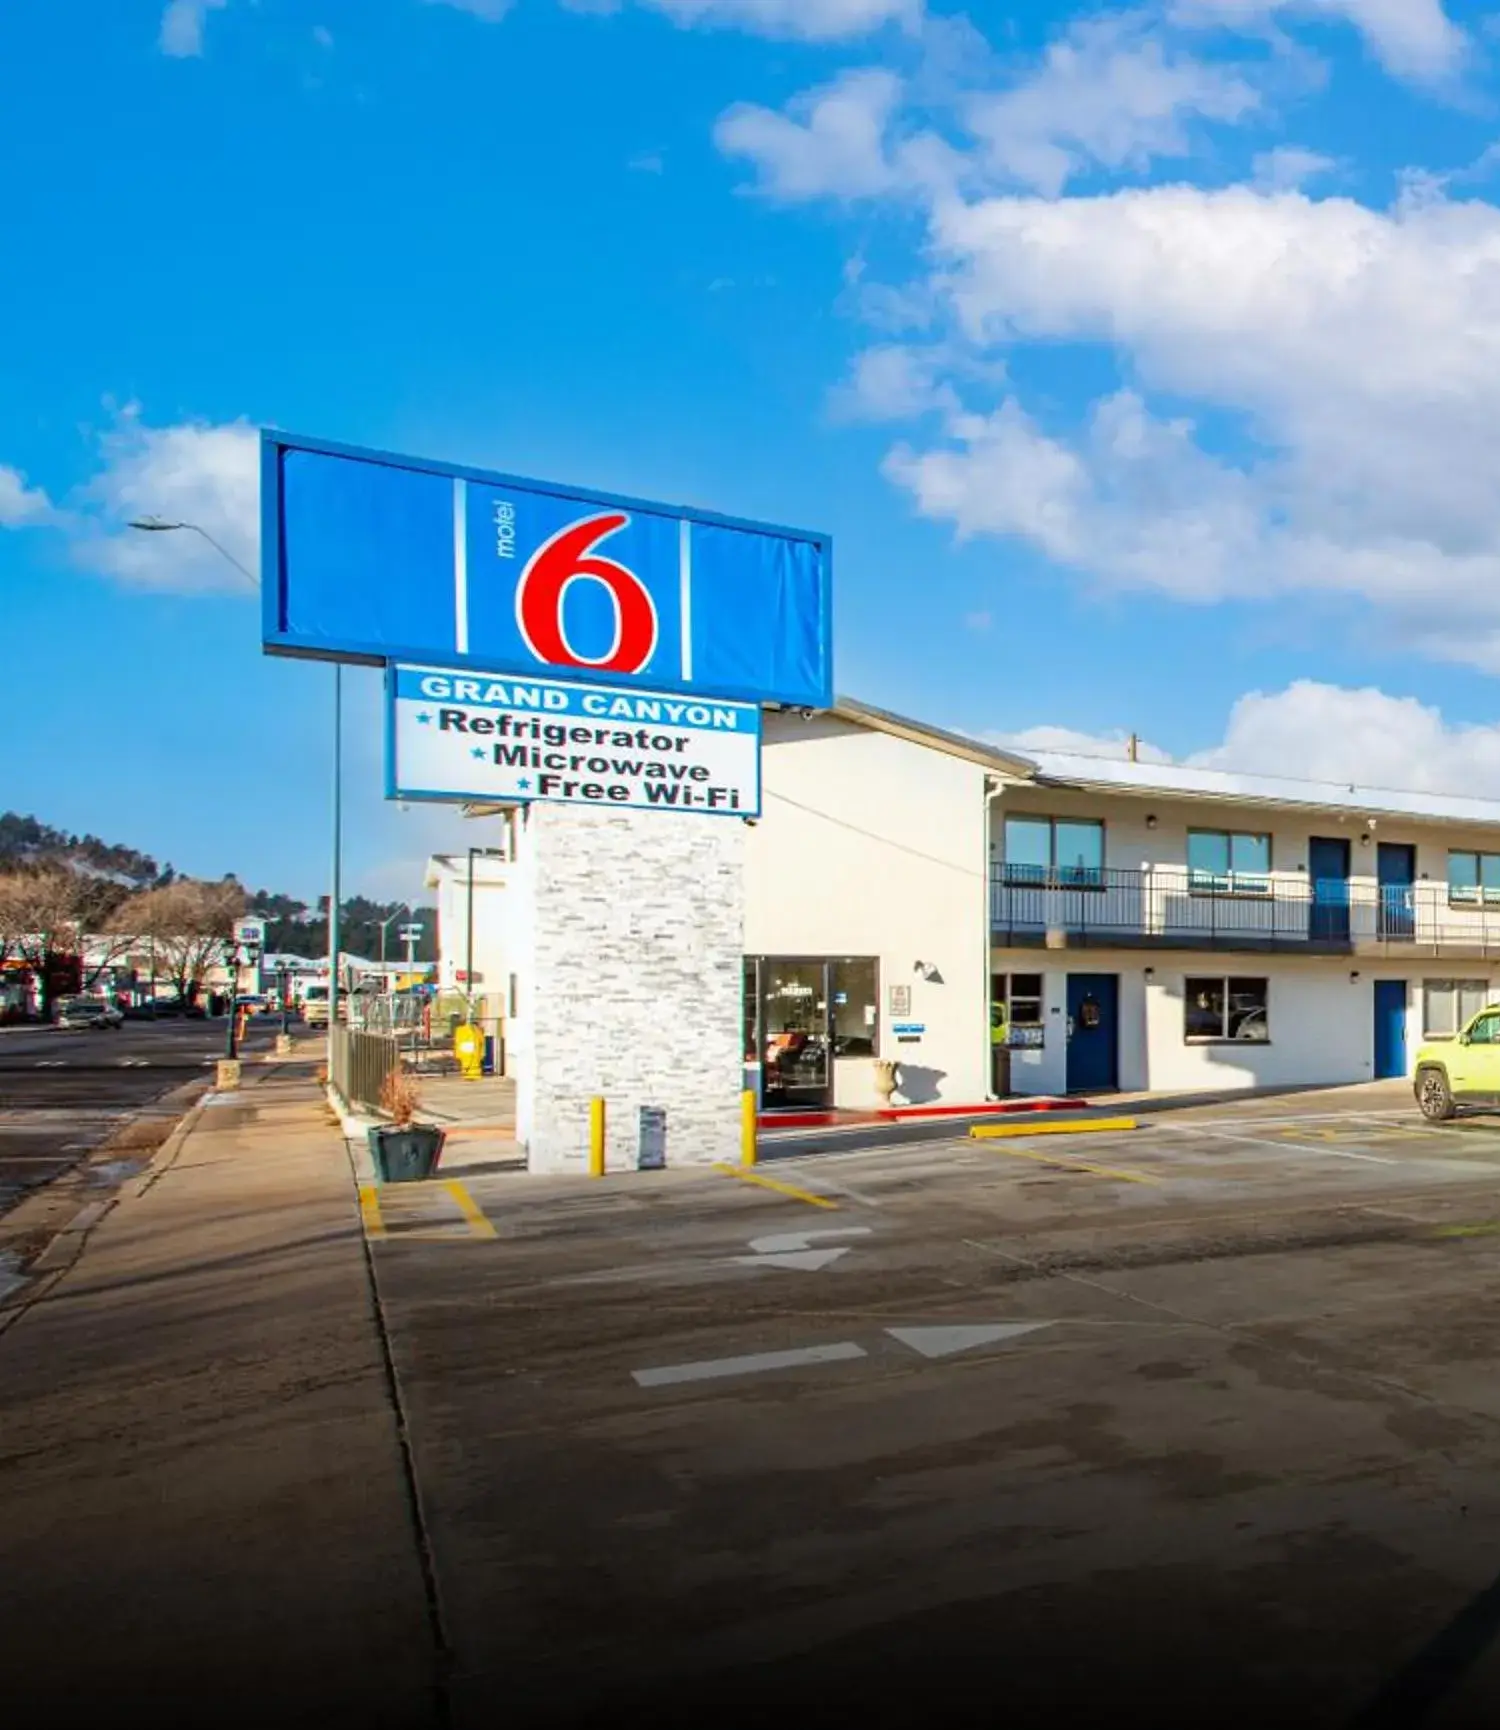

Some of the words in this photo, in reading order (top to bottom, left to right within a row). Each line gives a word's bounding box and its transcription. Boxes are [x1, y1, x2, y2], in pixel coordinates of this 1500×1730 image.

[493, 500, 516, 559] motel
[515, 509, 659, 675] 6
[420, 676, 569, 711] GRAND
[581, 694, 738, 730] CANYON
[438, 708, 691, 753] Refrigerator
[492, 743, 711, 782] Microwave
[538, 773, 631, 802] Free
[643, 781, 740, 809] Wi-Fi
